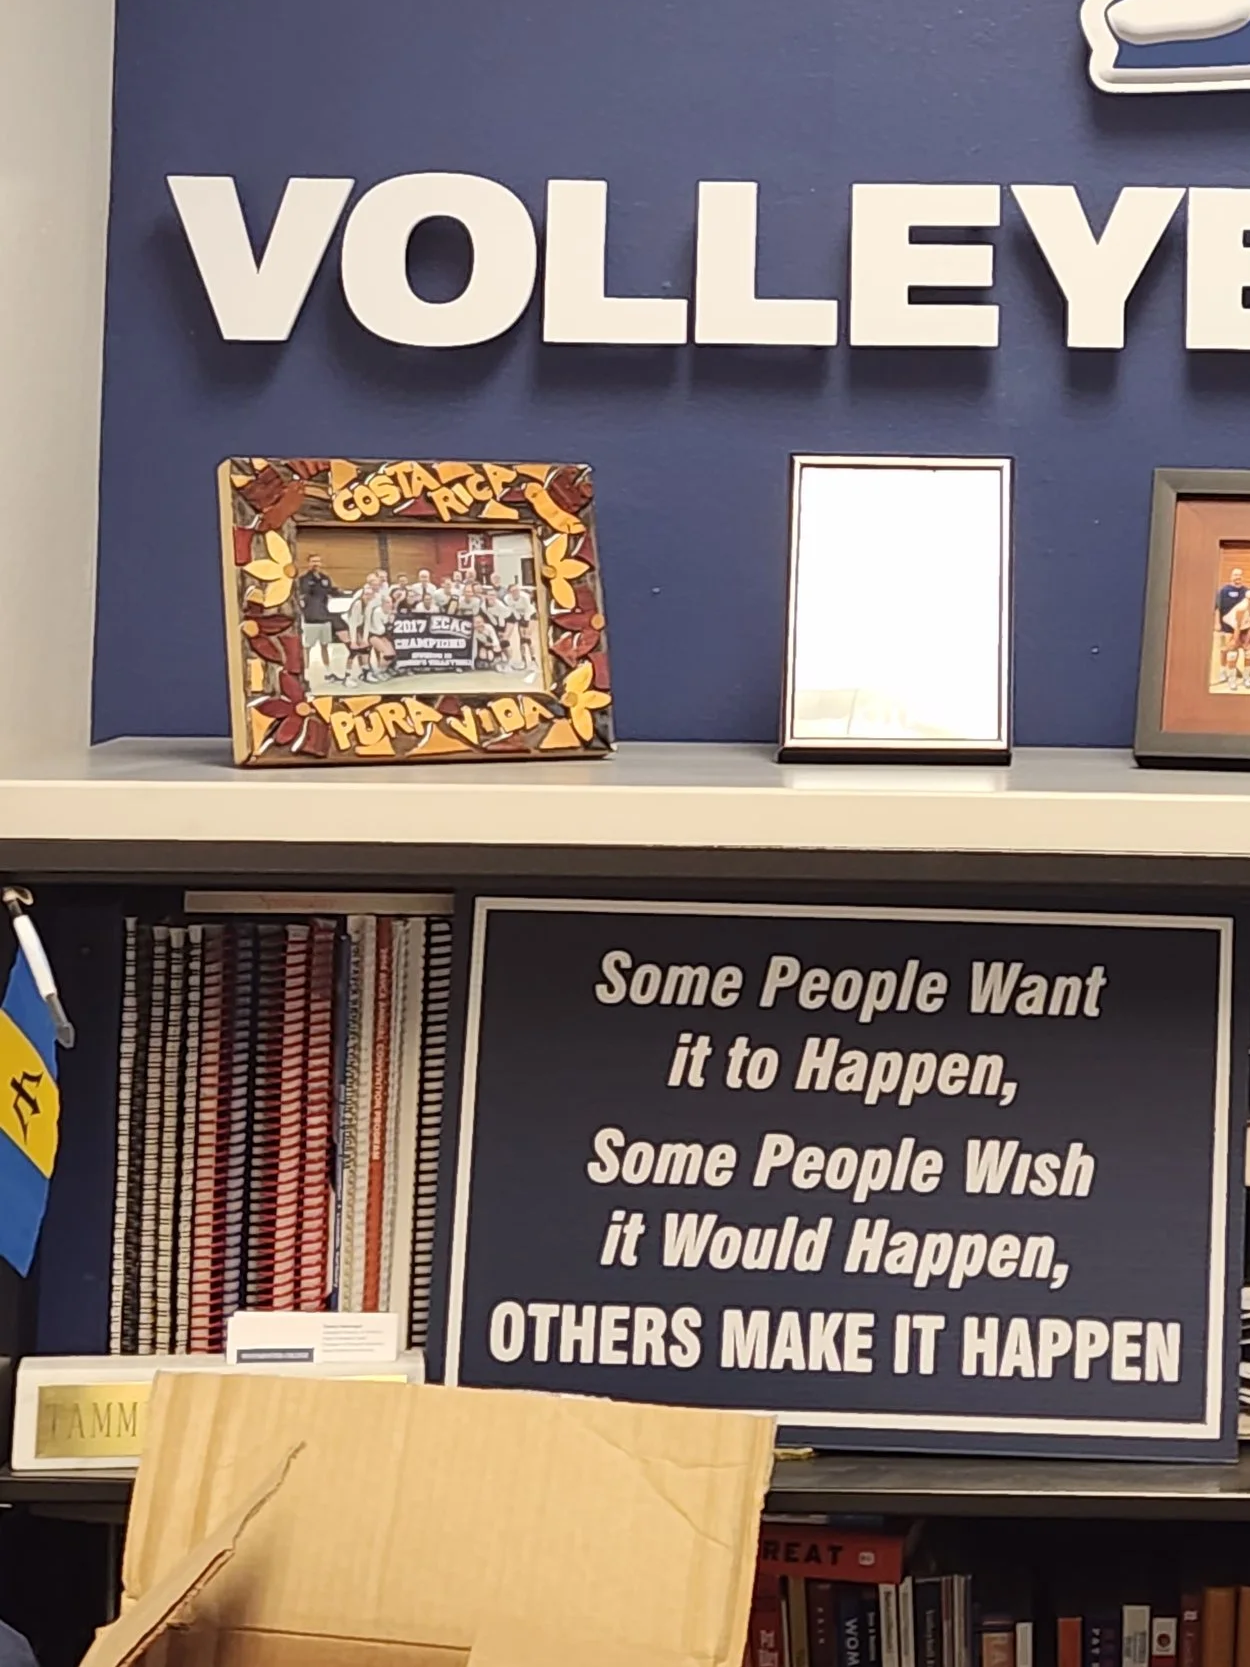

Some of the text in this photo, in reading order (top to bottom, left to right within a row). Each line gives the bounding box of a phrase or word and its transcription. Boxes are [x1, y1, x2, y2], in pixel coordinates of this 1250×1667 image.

[331, 461, 518, 522] COSTA RICA
[393, 615, 473, 635] 2017 ECAC
[330, 694, 553, 751] PURA VIDA
[595, 950, 1106, 1023] Some People Want
[374, 1043, 385, 1109] CONVENTION
[667, 1033, 1018, 1106] it to Happen,
[372, 1110, 382, 1161] PROGRAM
[587, 1127, 737, 1187] Some
[752, 1133, 944, 1203] People
[600, 1210, 1069, 1289] it Would Happen,
[489, 1301, 1181, 1382] OTHERS MAKE IT HAPPEN
[45, 1401, 138, 1440] TAMM
[762, 1539, 843, 1566] REAT
[844, 1616, 861, 1667] WOM
